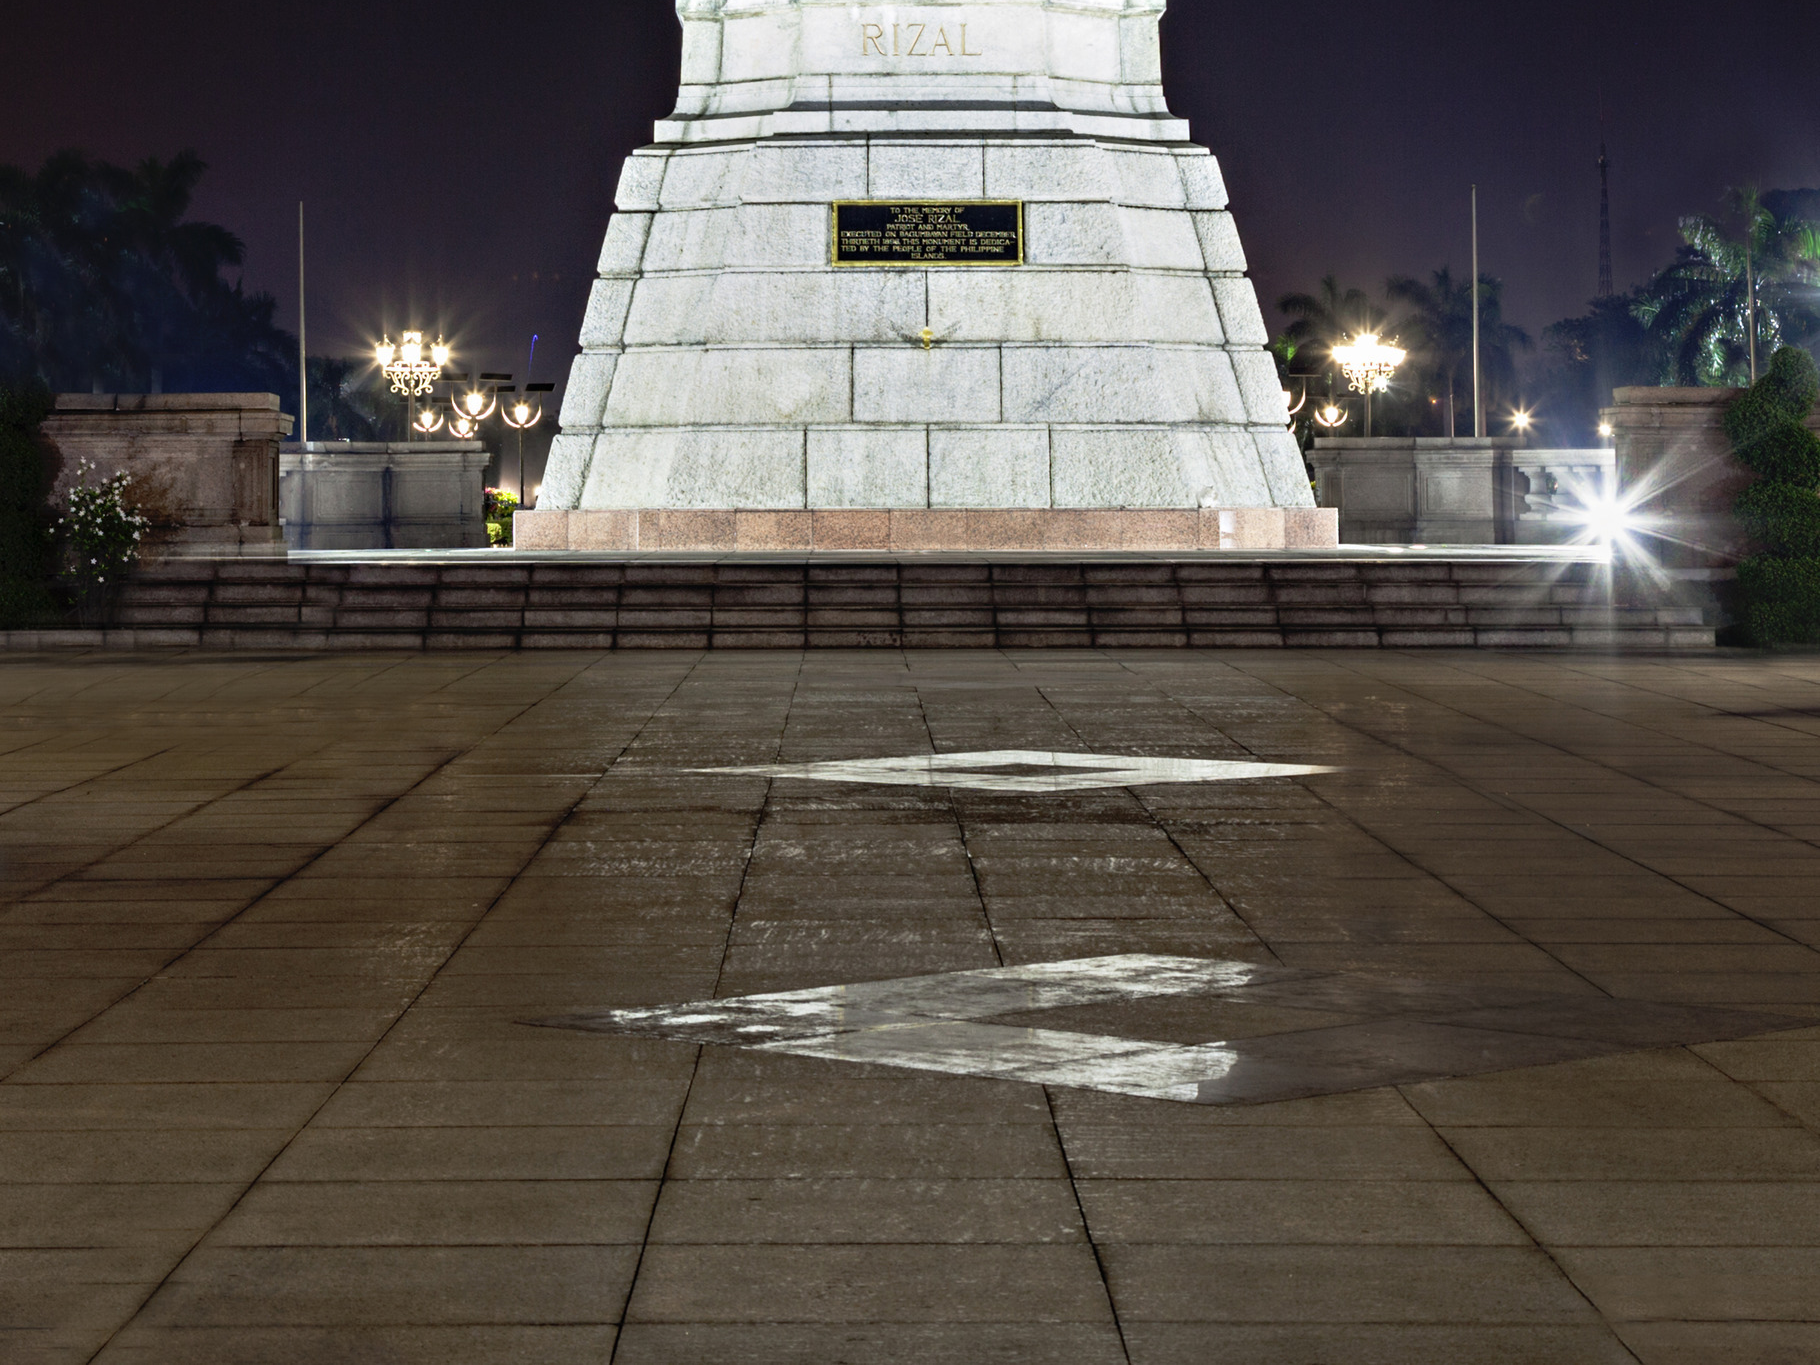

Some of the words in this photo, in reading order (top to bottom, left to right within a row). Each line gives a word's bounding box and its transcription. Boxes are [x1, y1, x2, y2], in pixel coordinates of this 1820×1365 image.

[861, 23, 983, 56] RIZAL
[840, 230, 882, 238] EXECUTED
[885, 230, 896, 238] ON
[899, 230, 948, 238] BAGUMBAYAN
